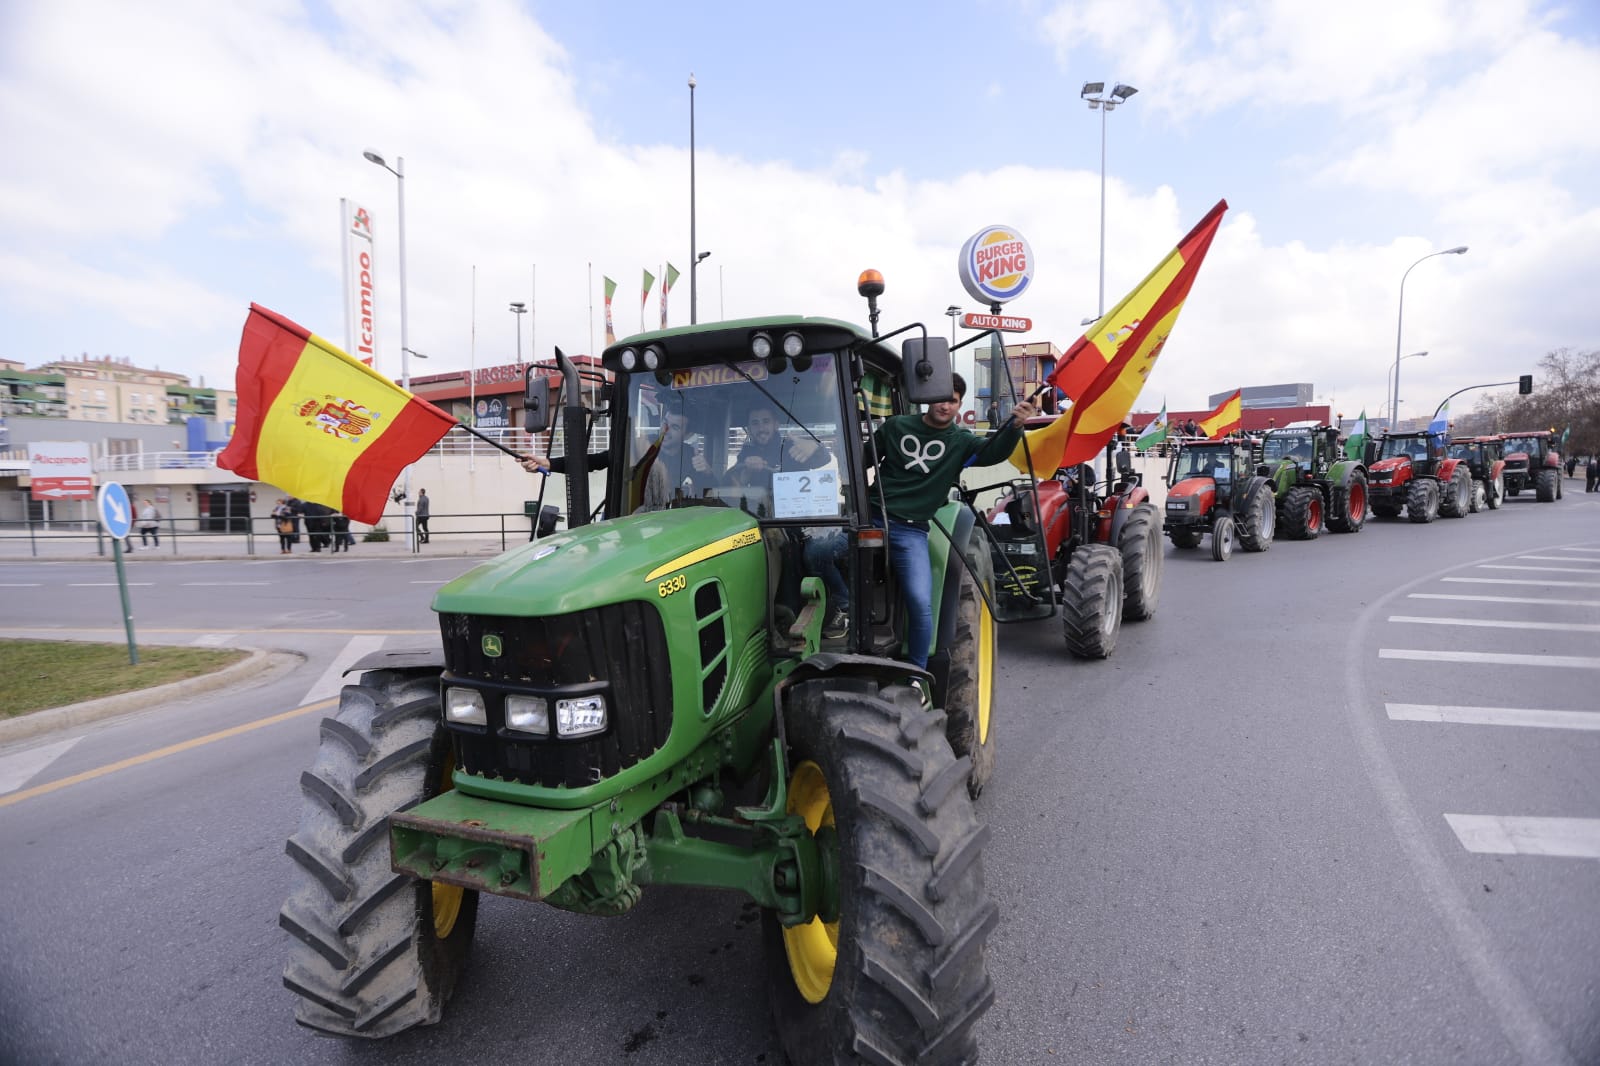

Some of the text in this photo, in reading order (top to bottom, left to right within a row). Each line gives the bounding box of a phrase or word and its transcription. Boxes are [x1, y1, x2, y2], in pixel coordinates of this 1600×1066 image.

[977, 242, 1023, 264] BURGER
[979, 254, 1026, 283] KING
[971, 315, 1026, 329] AUTO KING
[463, 359, 558, 384] BURGER KNG
[799, 476, 811, 493] 2
[658, 574, 687, 598] 6330
